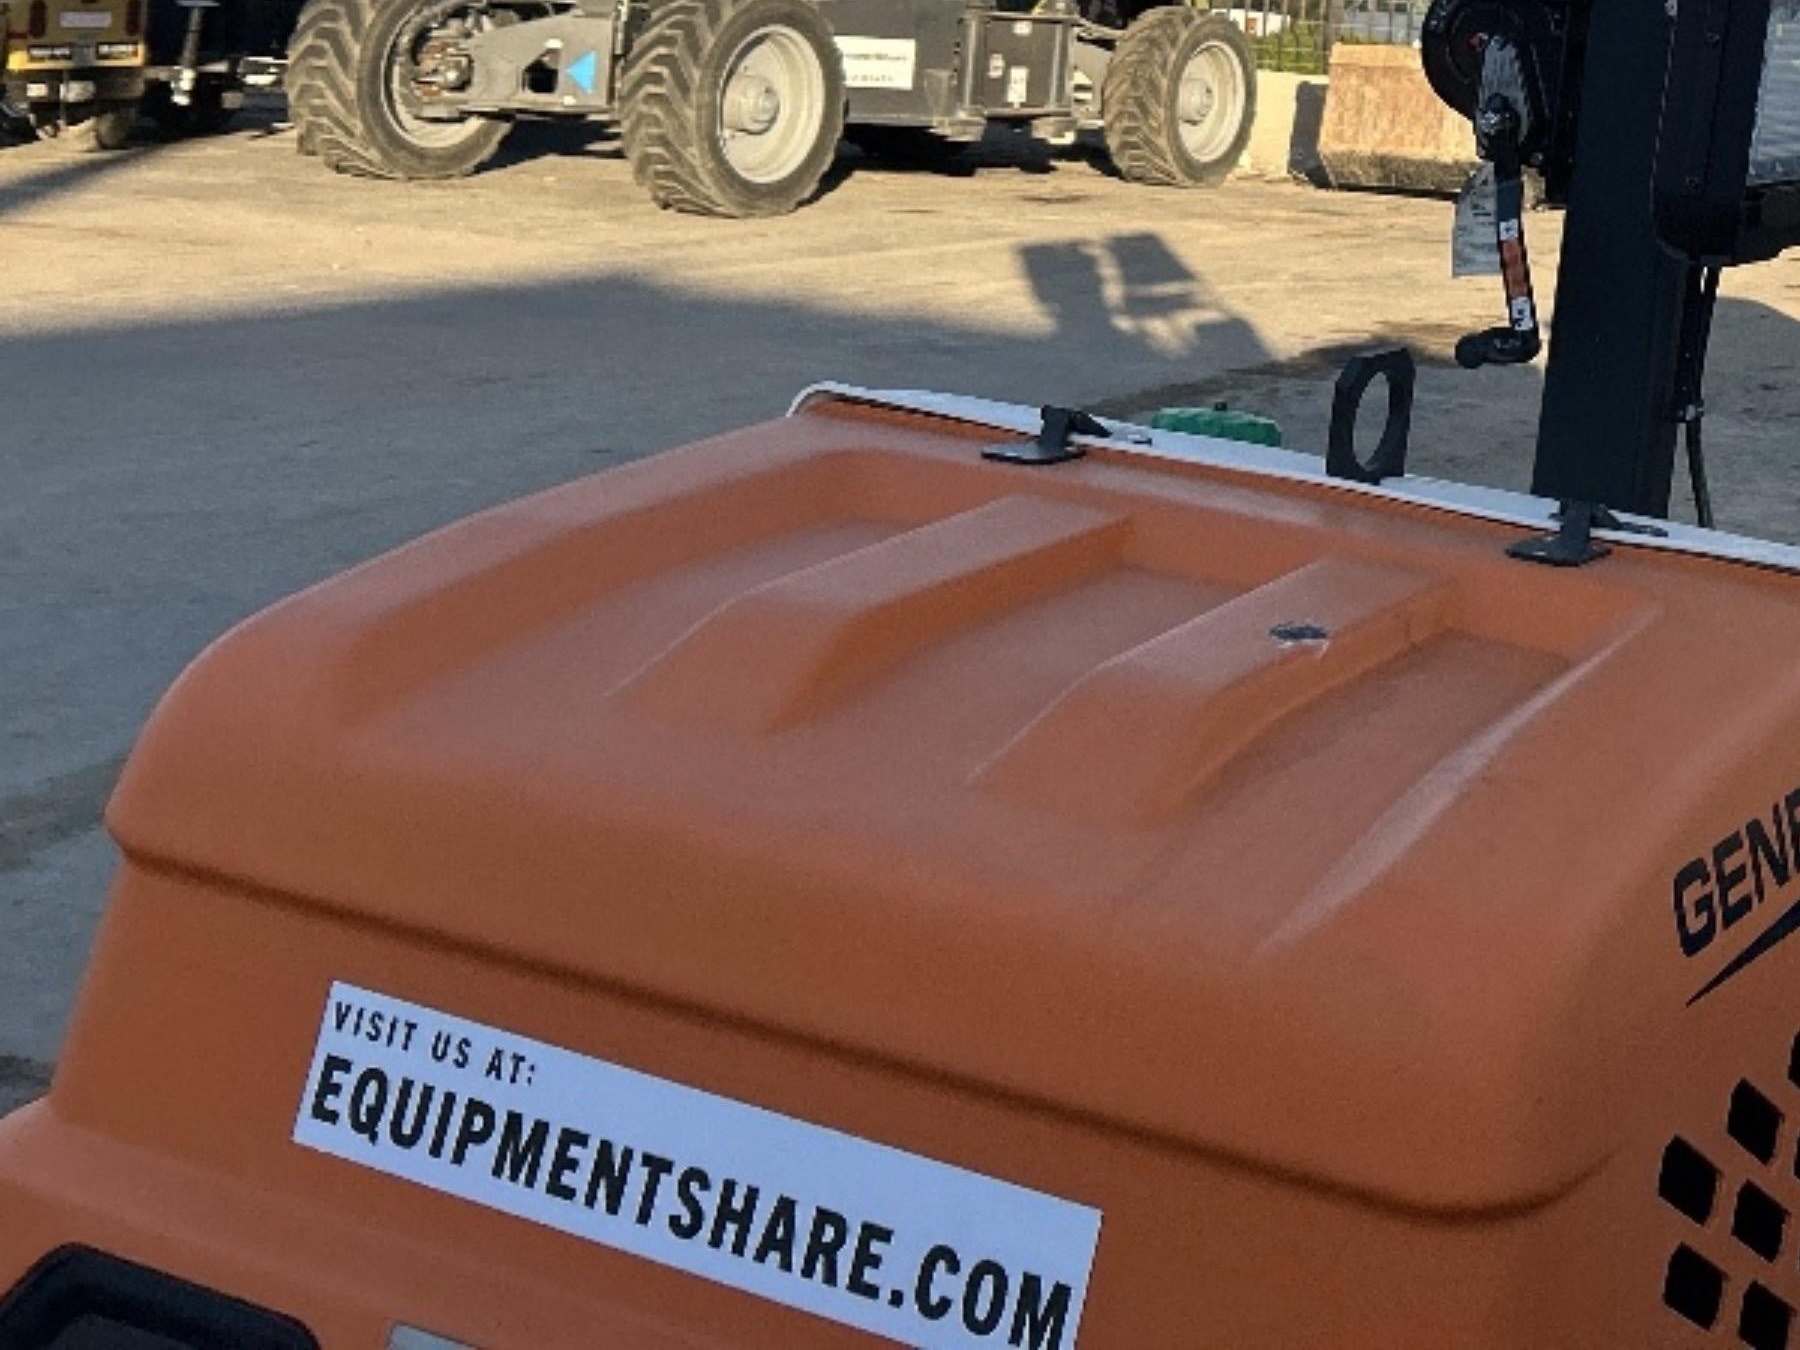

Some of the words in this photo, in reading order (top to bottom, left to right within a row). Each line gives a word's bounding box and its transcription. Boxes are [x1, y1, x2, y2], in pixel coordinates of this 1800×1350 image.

[334, 1001, 418, 1051] VISIT
[431, 1030, 472, 1069] US
[485, 1046, 537, 1086] AT:
[310, 1052, 1073, 1350] EQUIPMENTSHARE.COM
